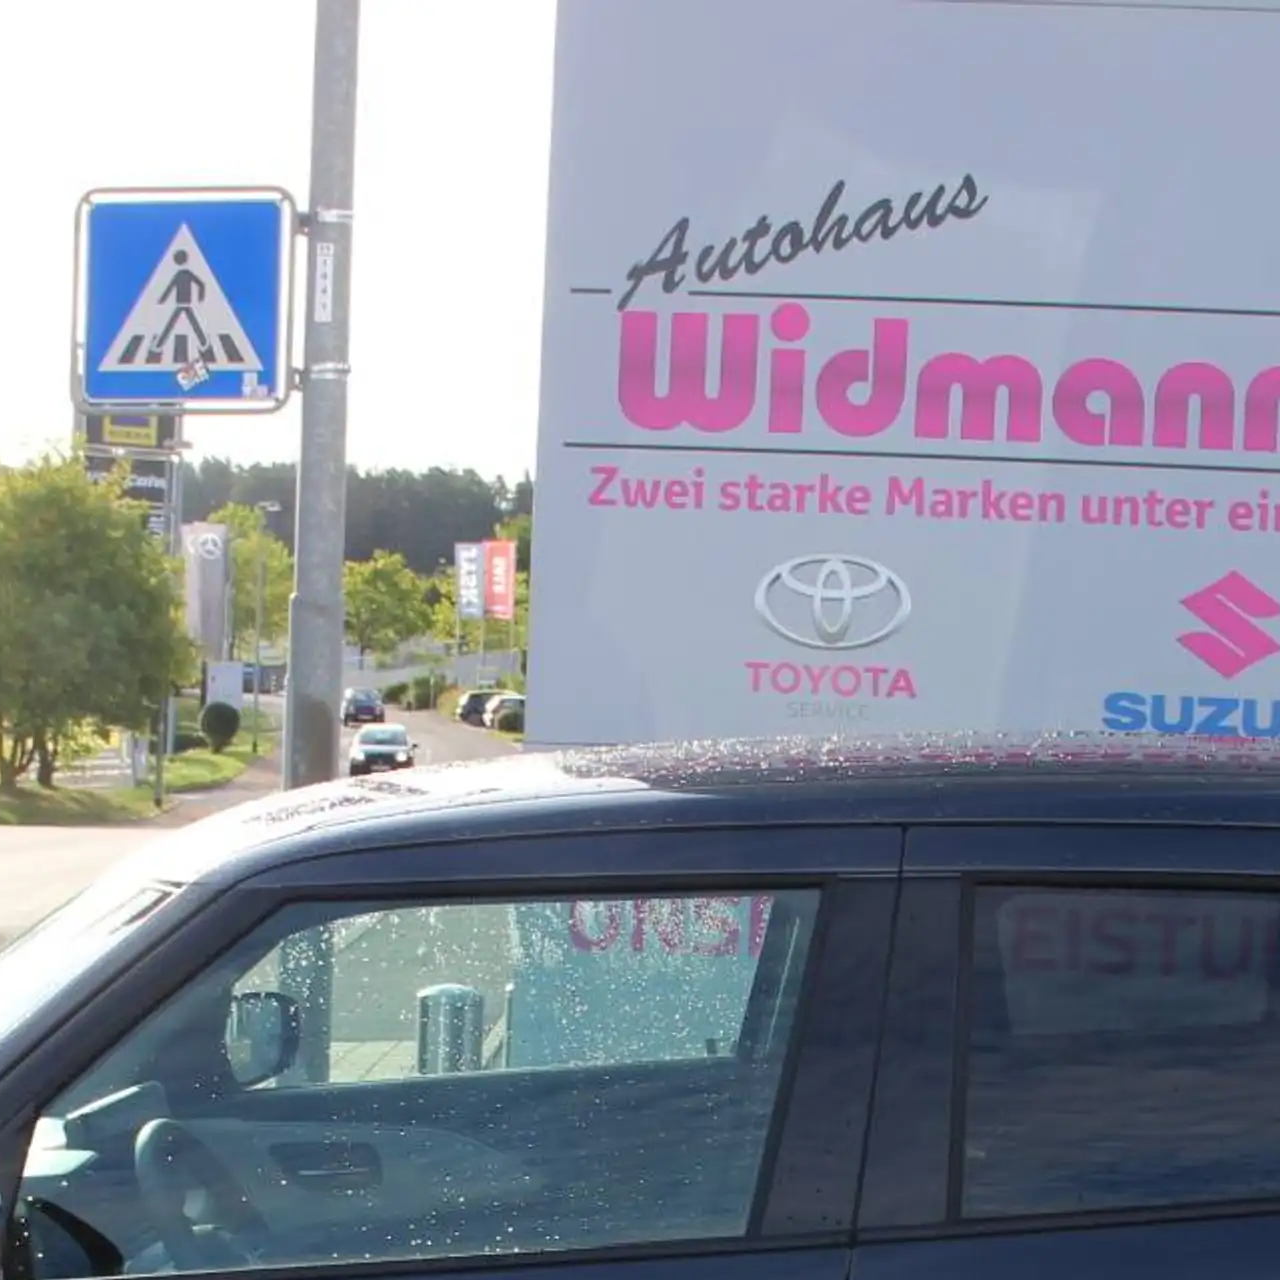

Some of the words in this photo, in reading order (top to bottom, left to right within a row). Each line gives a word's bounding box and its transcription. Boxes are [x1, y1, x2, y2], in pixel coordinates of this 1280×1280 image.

[618, 174, 989, 310] Autohaus
[588, 464, 706, 512] Zwei
[719, 473, 873, 516] starke
[885, 476, 1066, 524] Marken
[1080, 490, 1215, 531] unter
[746, 660, 917, 698] TOYOTA
[785, 700, 870, 722] SERVICE
